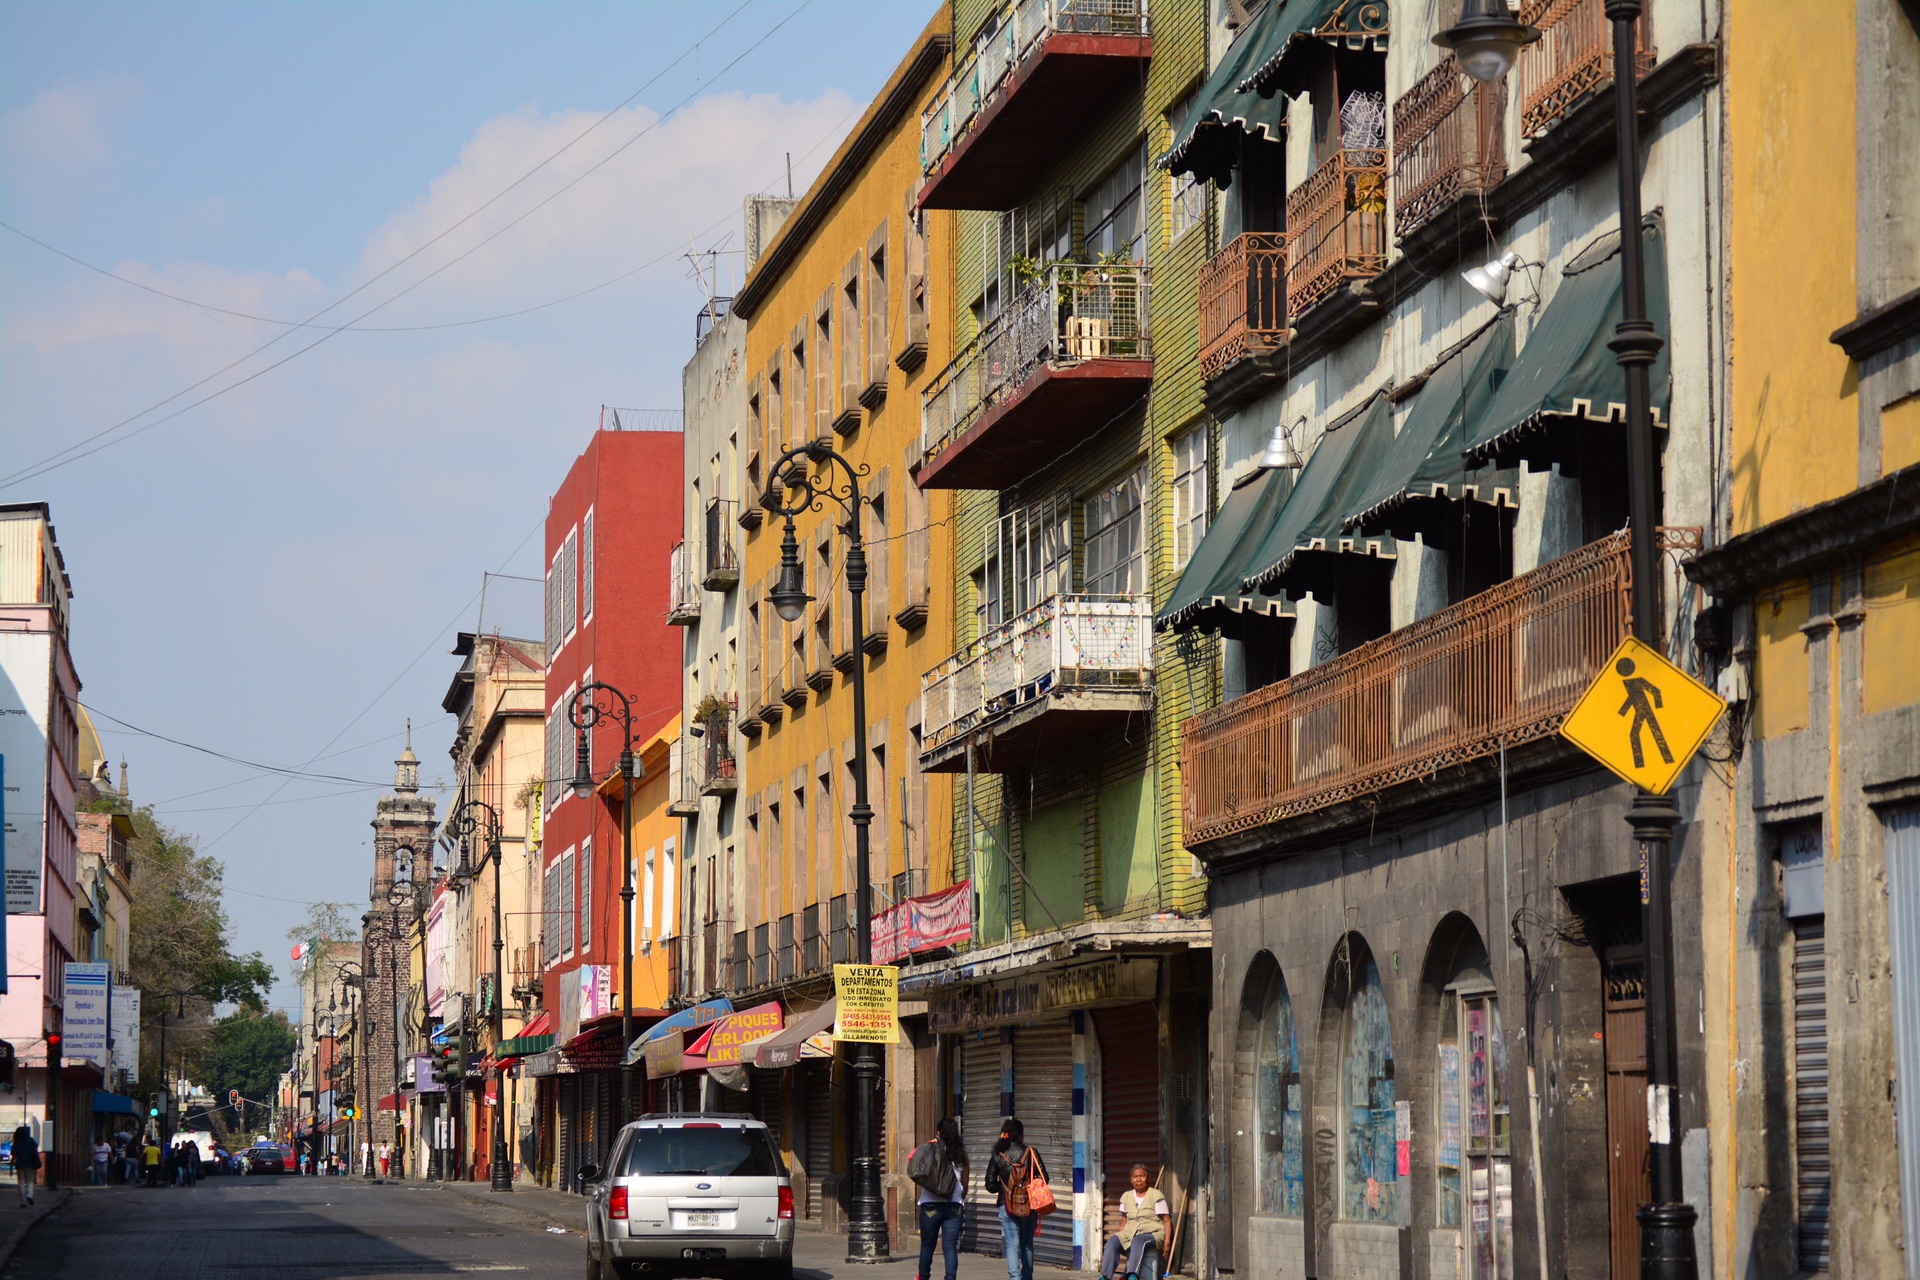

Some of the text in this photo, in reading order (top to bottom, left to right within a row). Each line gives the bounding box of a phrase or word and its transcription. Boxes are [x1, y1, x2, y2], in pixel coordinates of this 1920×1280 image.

[849, 968, 884, 977] VENTA
[841, 977, 893, 987] DEPARTAMENTOS
[870, 988, 885, 996] ZONA
[728, 1012, 779, 1029] PIQUES
